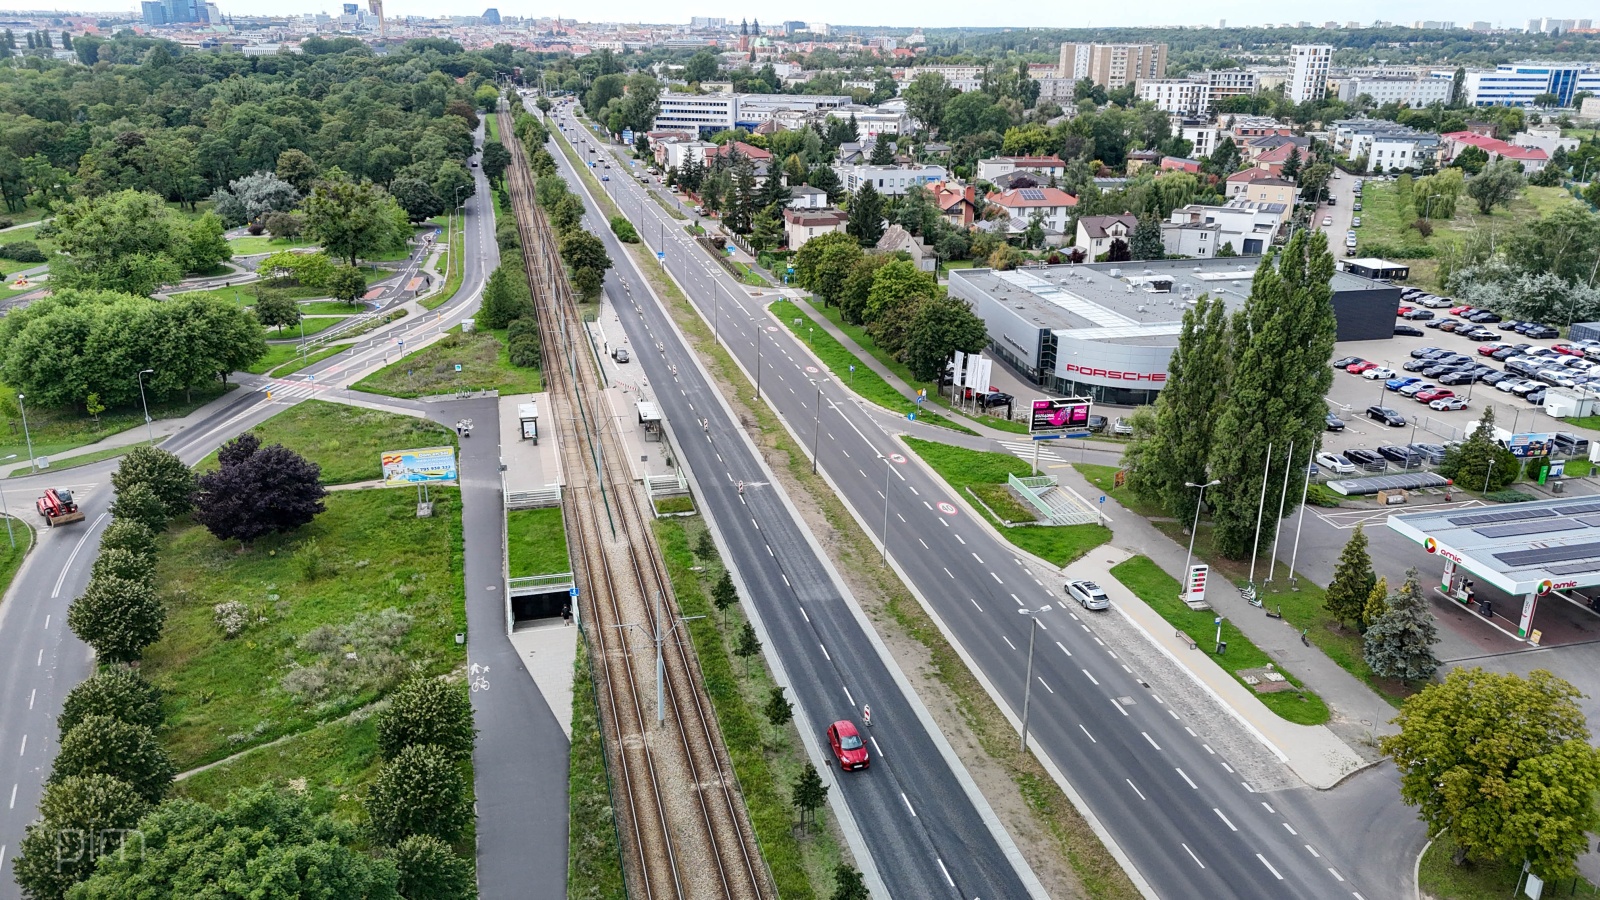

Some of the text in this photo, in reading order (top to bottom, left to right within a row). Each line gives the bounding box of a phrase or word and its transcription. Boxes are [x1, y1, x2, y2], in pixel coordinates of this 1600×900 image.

[1066, 363, 1167, 381] PORSCHE
[941, 504, 954, 512] 40
[1440, 549, 1463, 564] amic
[1553, 580, 1578, 589] amic
